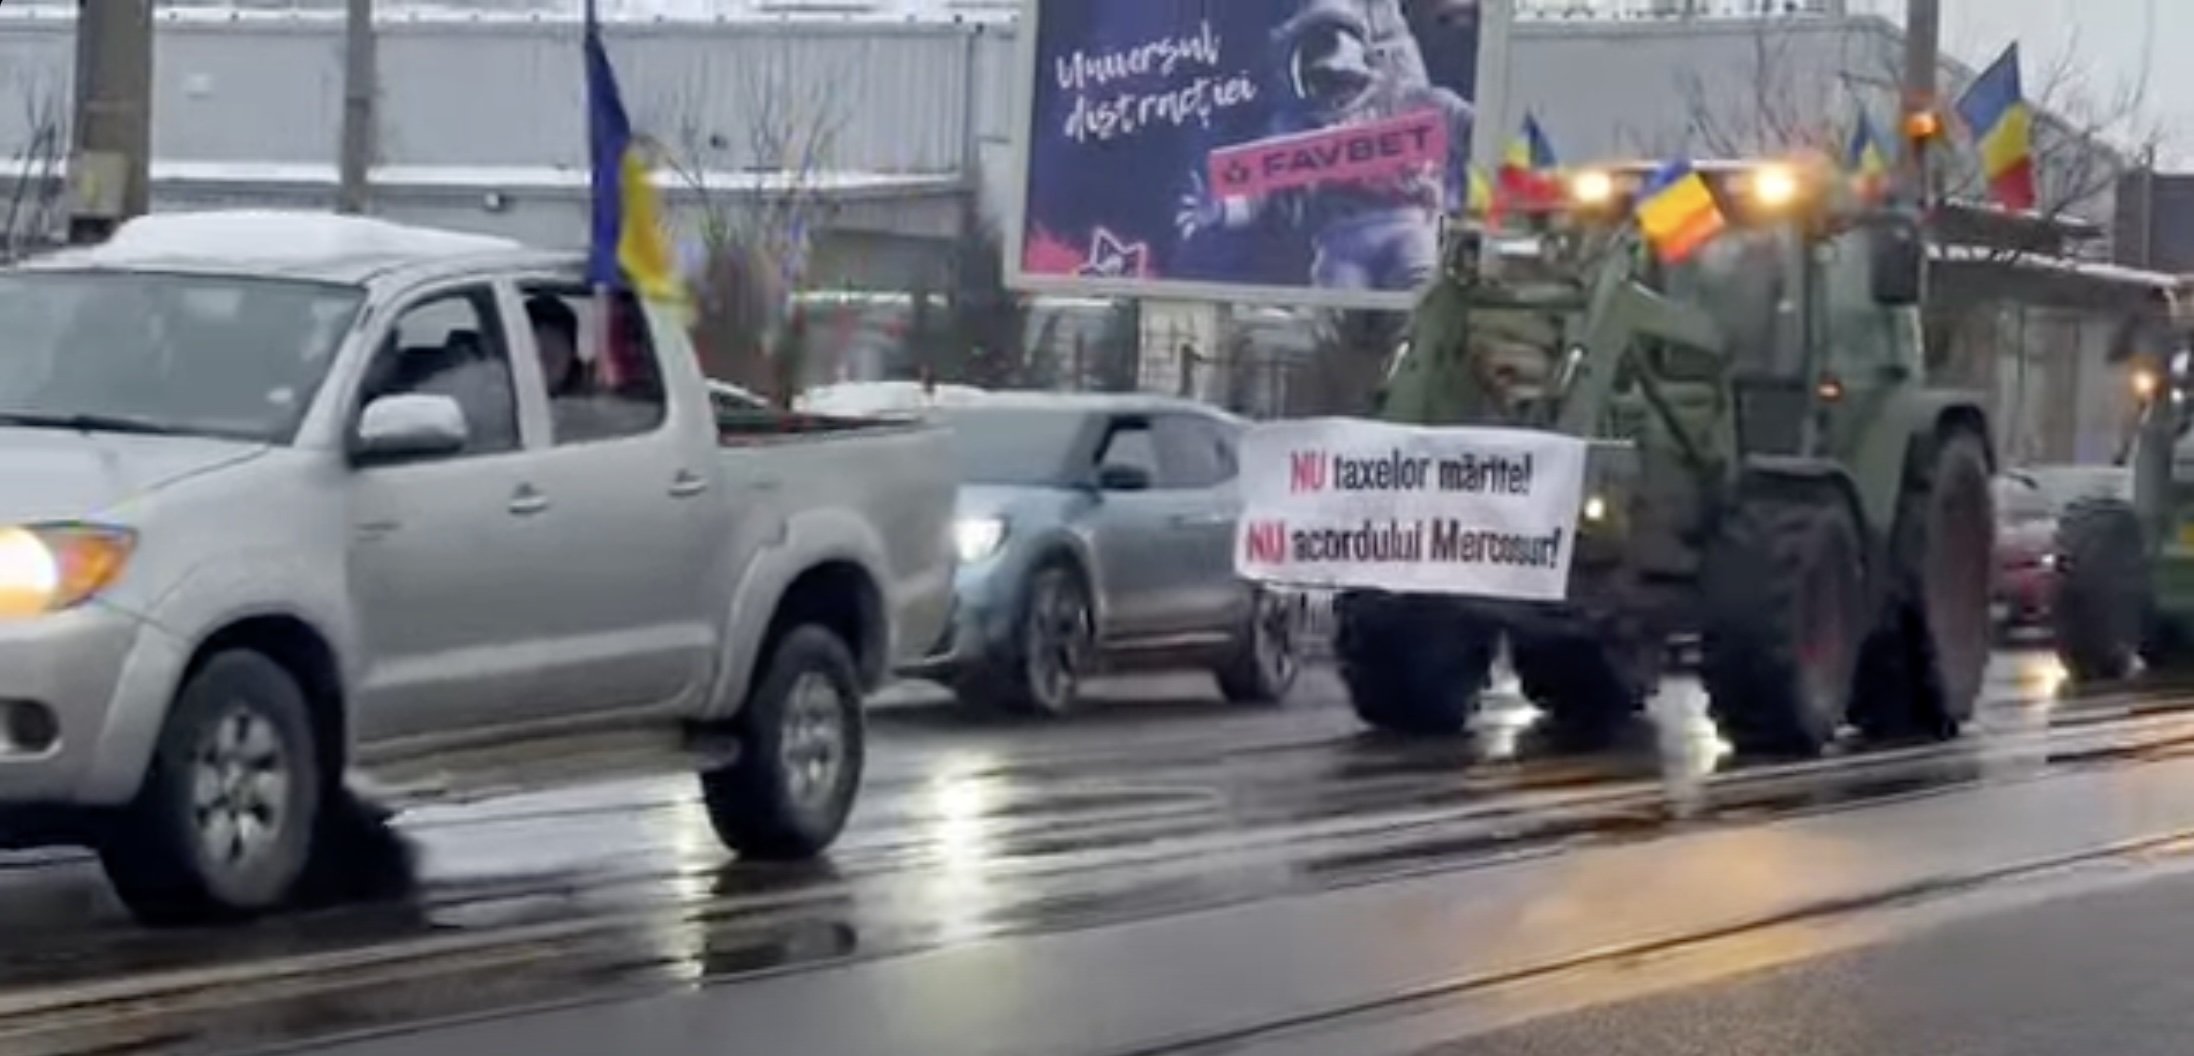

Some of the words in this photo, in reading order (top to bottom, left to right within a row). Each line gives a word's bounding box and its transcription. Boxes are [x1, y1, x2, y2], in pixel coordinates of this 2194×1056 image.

[1056, 21, 1223, 90] Universul
[1262, 124, 1433, 178] FAVBET
[1291, 450, 1326, 493] NU
[1334, 449, 1429, 490] taxelor
[1439, 452, 1533, 495] mărite!
[1246, 520, 1286, 564] NU
[1291, 519, 1421, 562] acordului
[1430, 518, 1561, 568] Mercosur!
